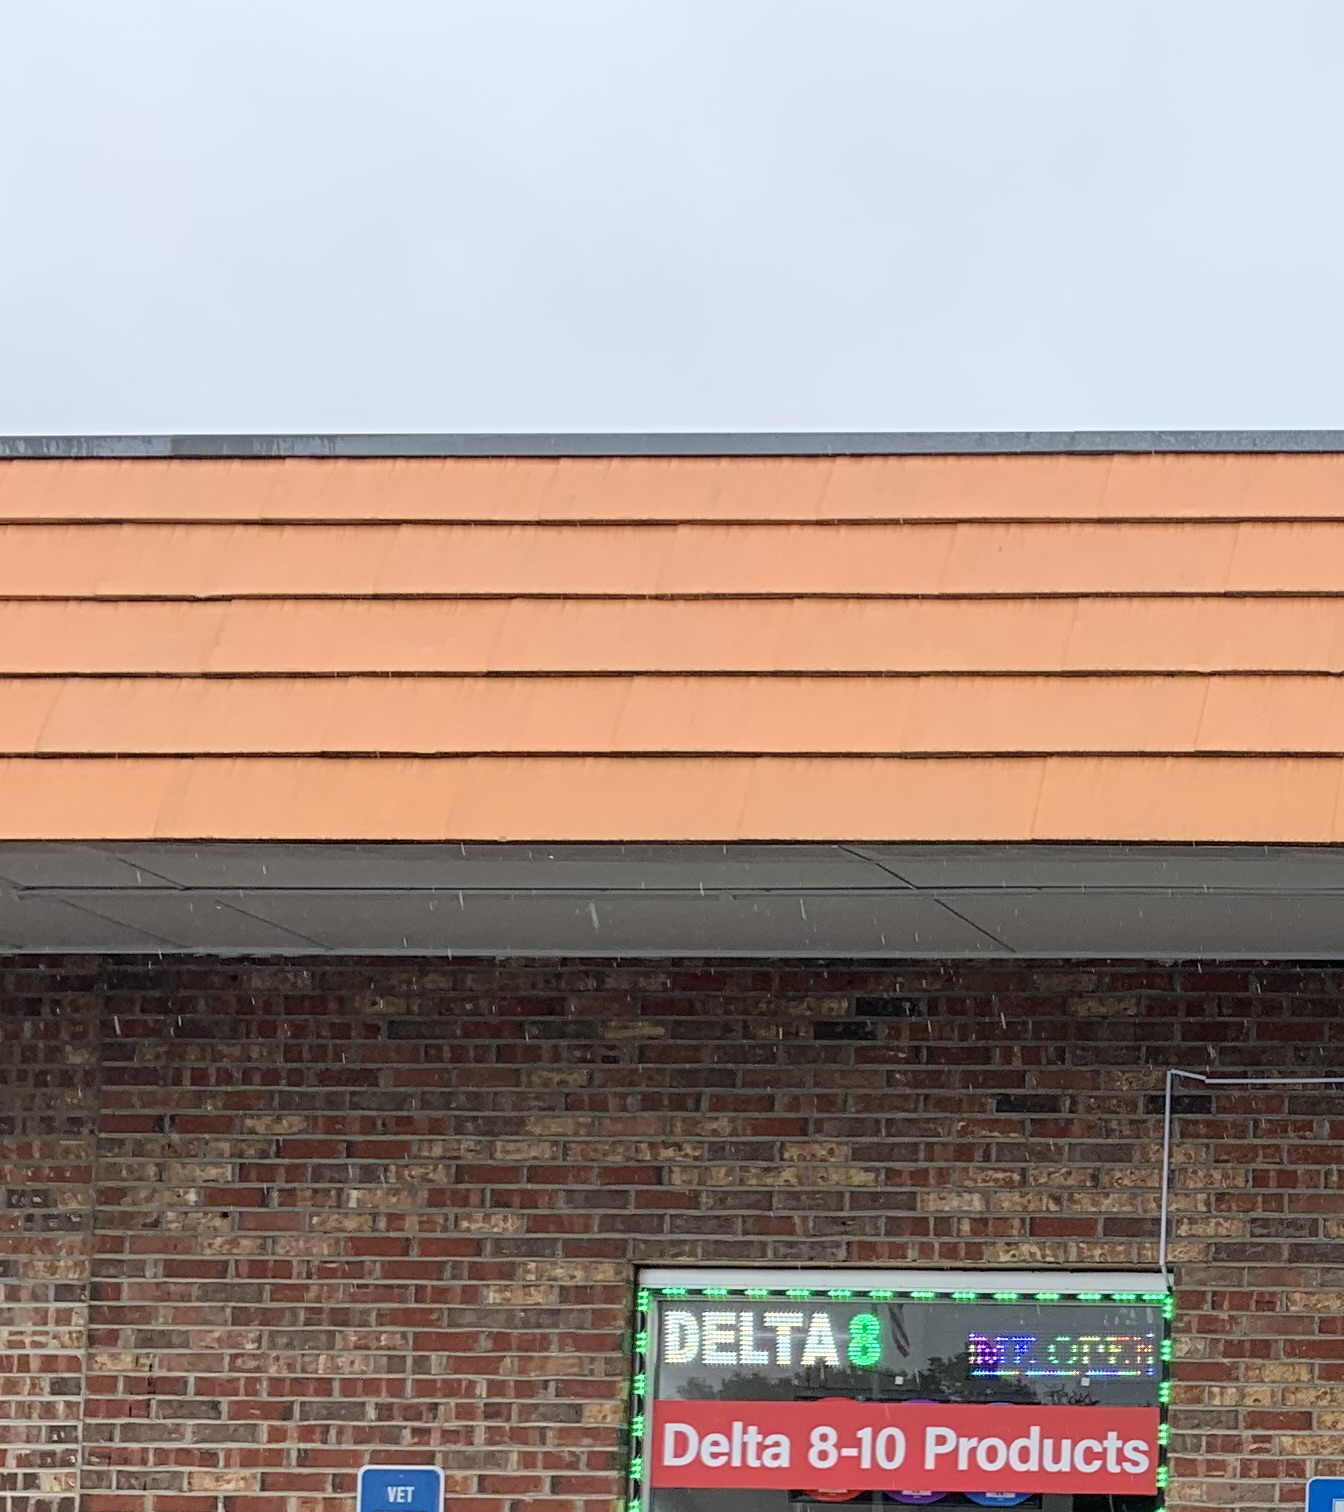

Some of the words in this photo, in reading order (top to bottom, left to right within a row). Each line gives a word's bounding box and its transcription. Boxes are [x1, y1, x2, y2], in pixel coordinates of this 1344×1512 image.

[663, 1310, 841, 1366] DELTA
[847, 1312, 882, 1367] 8
[662, 1420, 791, 1468] Delta
[807, 1425, 906, 1470] 8-10
[924, 1425, 1150, 1475] Products
[387, 1486, 415, 1503] VET
